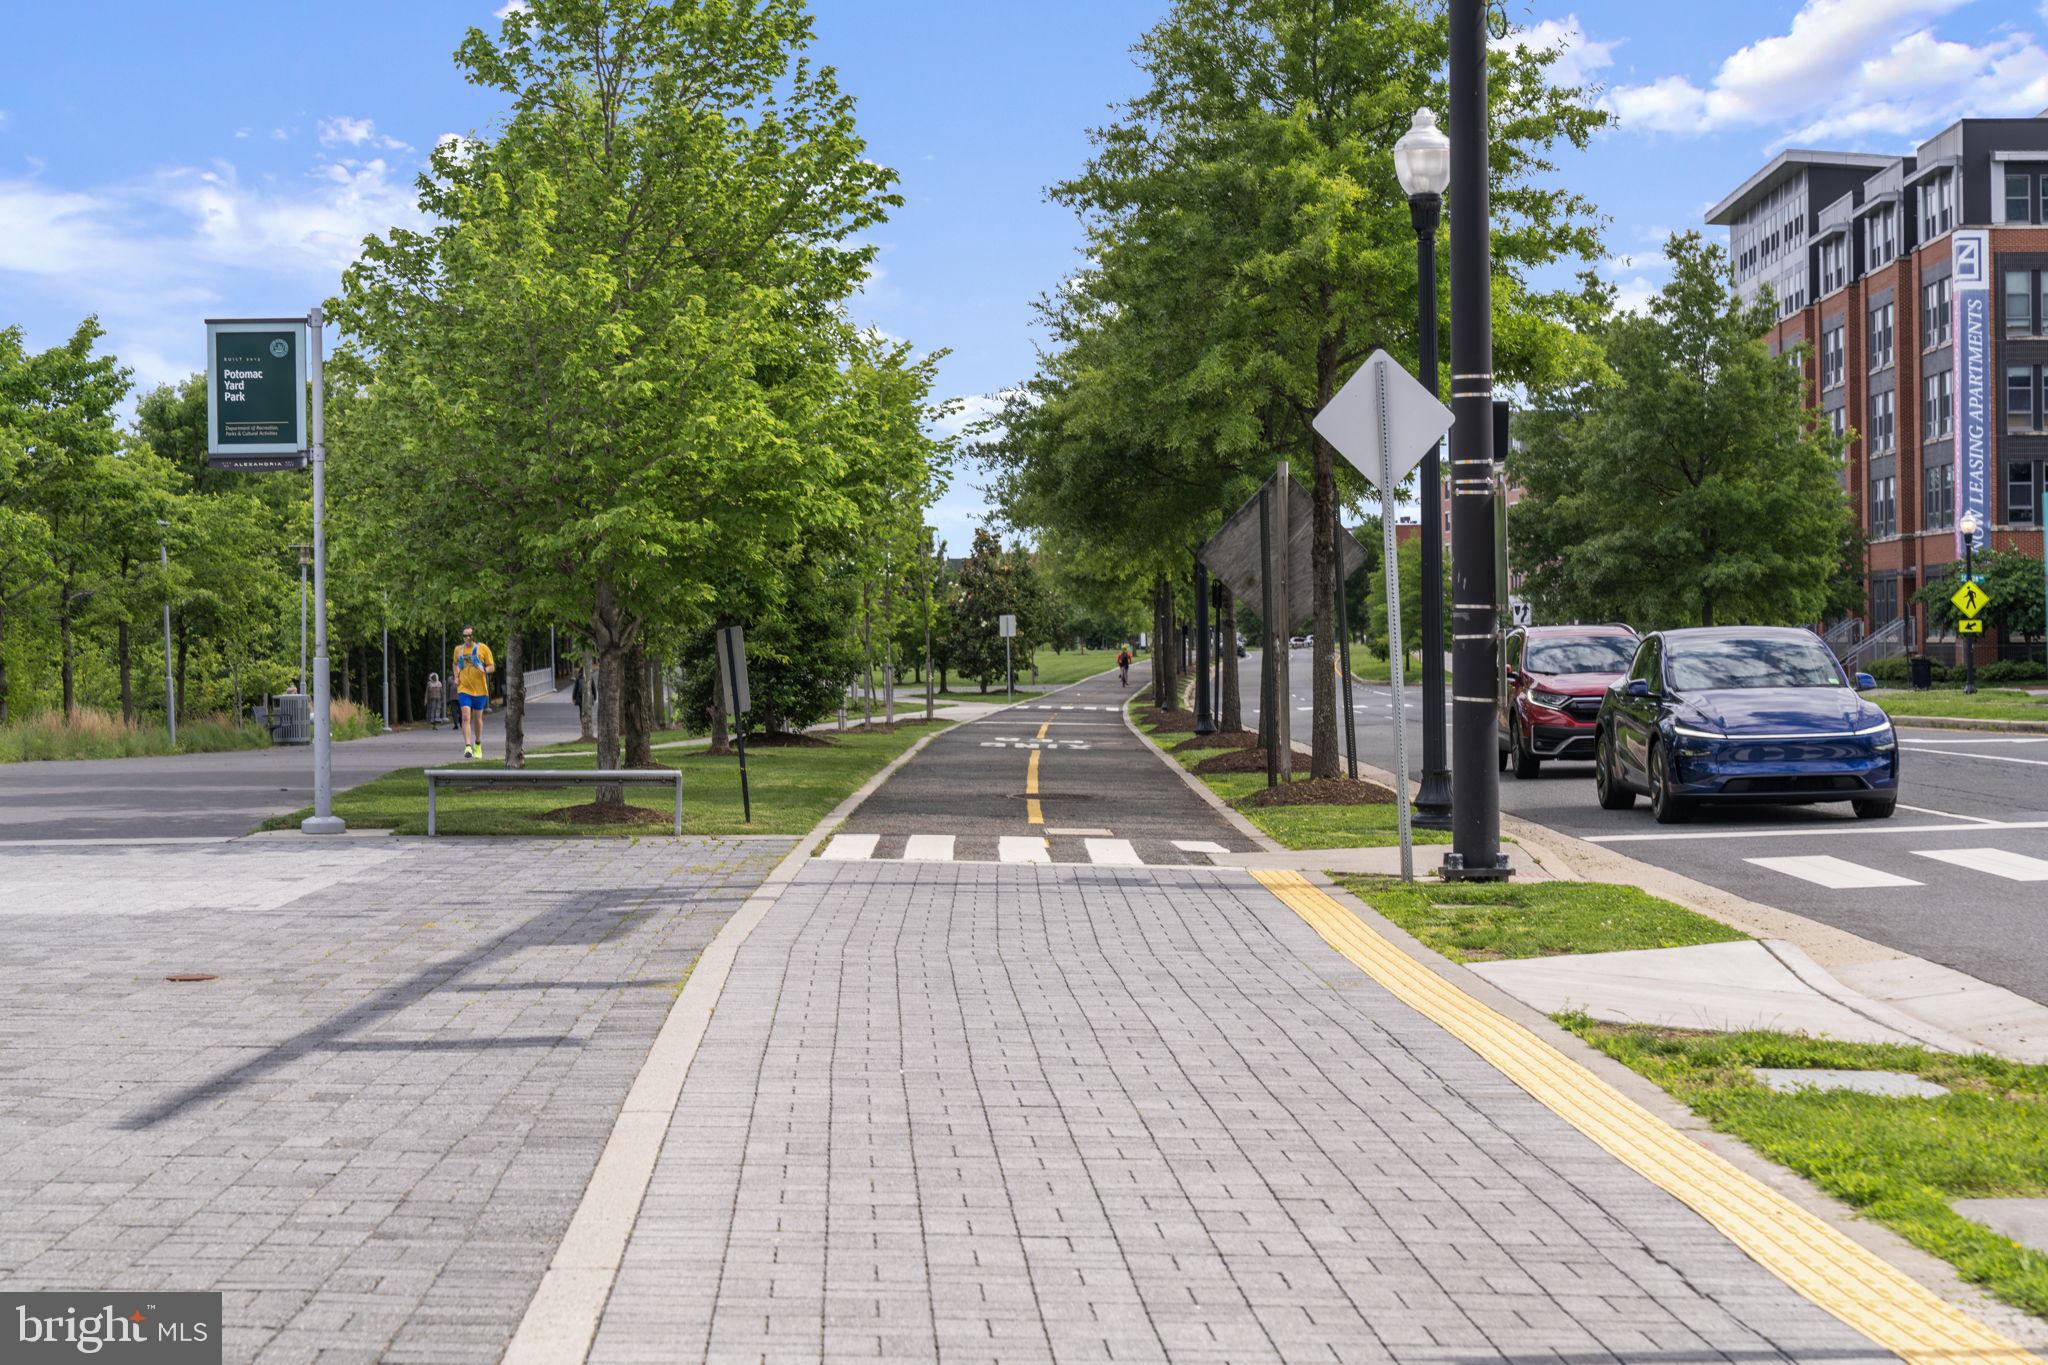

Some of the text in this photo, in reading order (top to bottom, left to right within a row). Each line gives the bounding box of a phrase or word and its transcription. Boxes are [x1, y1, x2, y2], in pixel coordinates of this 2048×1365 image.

[1968, 298, 1984, 424] APARTMENTS
[224, 369, 263, 379] Potomac
[224, 380, 245, 390] Yard
[224, 392, 246, 402] Park
[1968, 424, 1984, 504] LEASING
